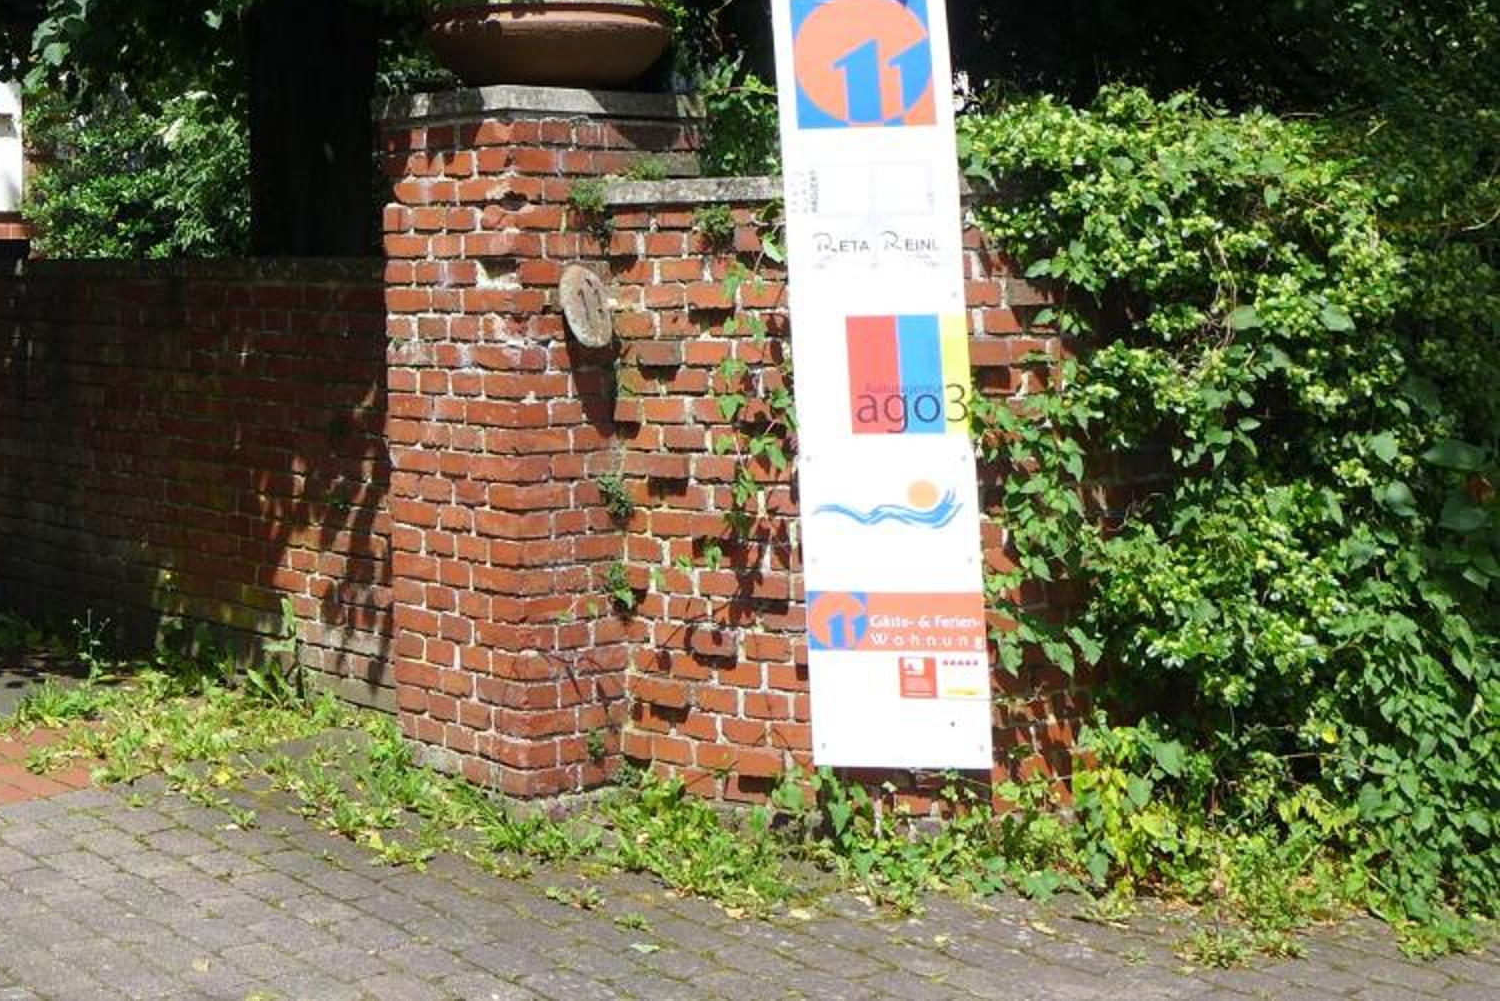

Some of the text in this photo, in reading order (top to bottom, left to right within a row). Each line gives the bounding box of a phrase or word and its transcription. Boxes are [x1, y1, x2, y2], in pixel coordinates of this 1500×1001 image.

[832, 37, 933, 123] 11
[812, 232, 871, 254] RETA
[856, 383, 969, 433] ago3
[870, 632, 985, 650] Wohnung
